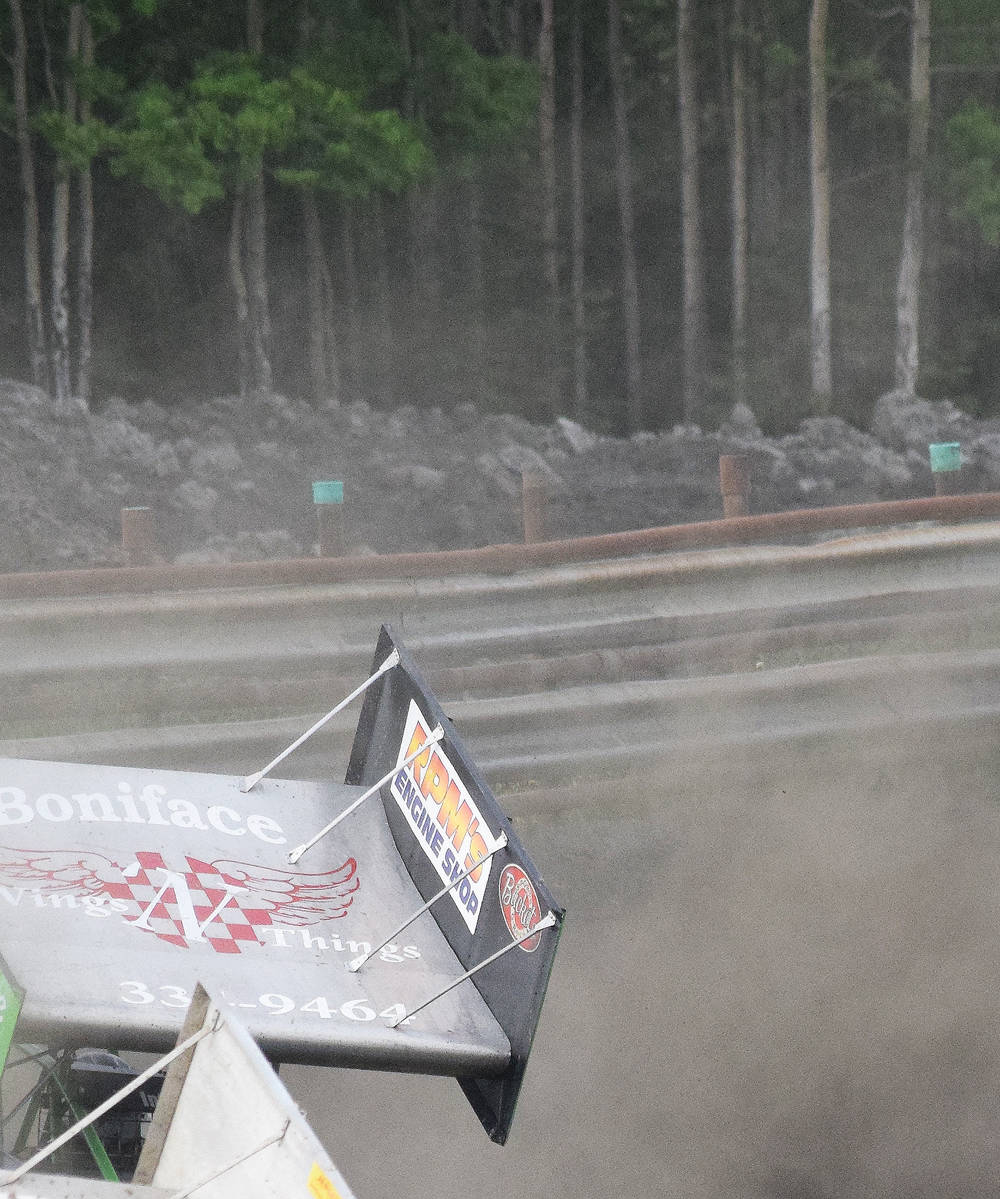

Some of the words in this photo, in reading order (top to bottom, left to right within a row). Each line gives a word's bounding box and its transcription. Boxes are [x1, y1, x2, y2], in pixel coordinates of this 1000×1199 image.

[394, 765, 445, 858] ENGINE
[440, 849, 479, 916] SHOP
[261, 927, 423, 963] Things
[119, 981, 416, 1025] 33-9464
